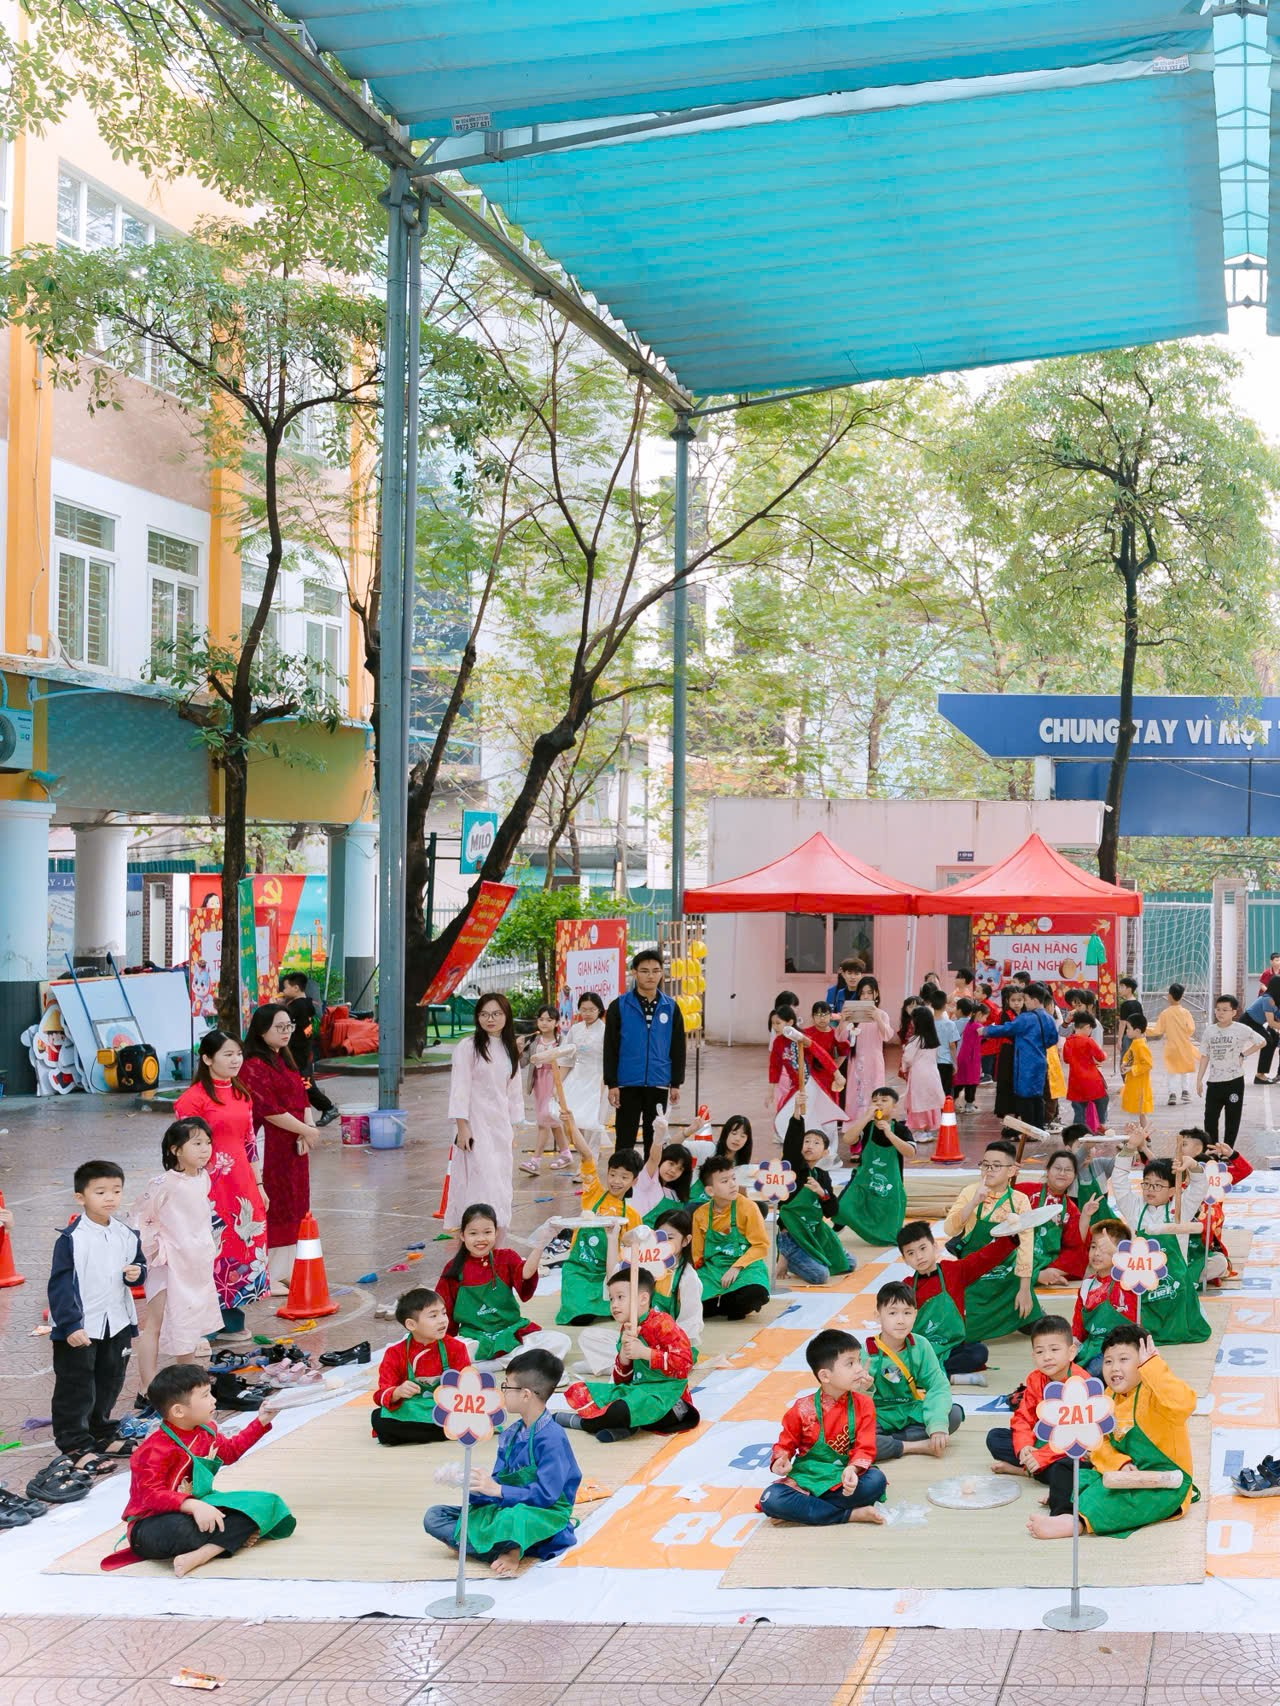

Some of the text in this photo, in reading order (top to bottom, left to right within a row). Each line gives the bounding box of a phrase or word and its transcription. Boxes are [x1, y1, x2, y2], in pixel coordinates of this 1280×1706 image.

[1039, 717, 1121, 745] CHUNG
[1132, 719, 1179, 745] TAY
[1186, 714, 1213, 745] VÌ
[470, 833, 492, 852] MILO
[1012, 943, 1040, 954] GIAN
[577, 961, 592, 977] GIAN
[766, 1173, 785, 1185] 5A1
[1127, 1257, 1152, 1271] 4A1
[453, 1393, 486, 1414] 2A2
[1058, 1404, 1093, 1425] 2A1
